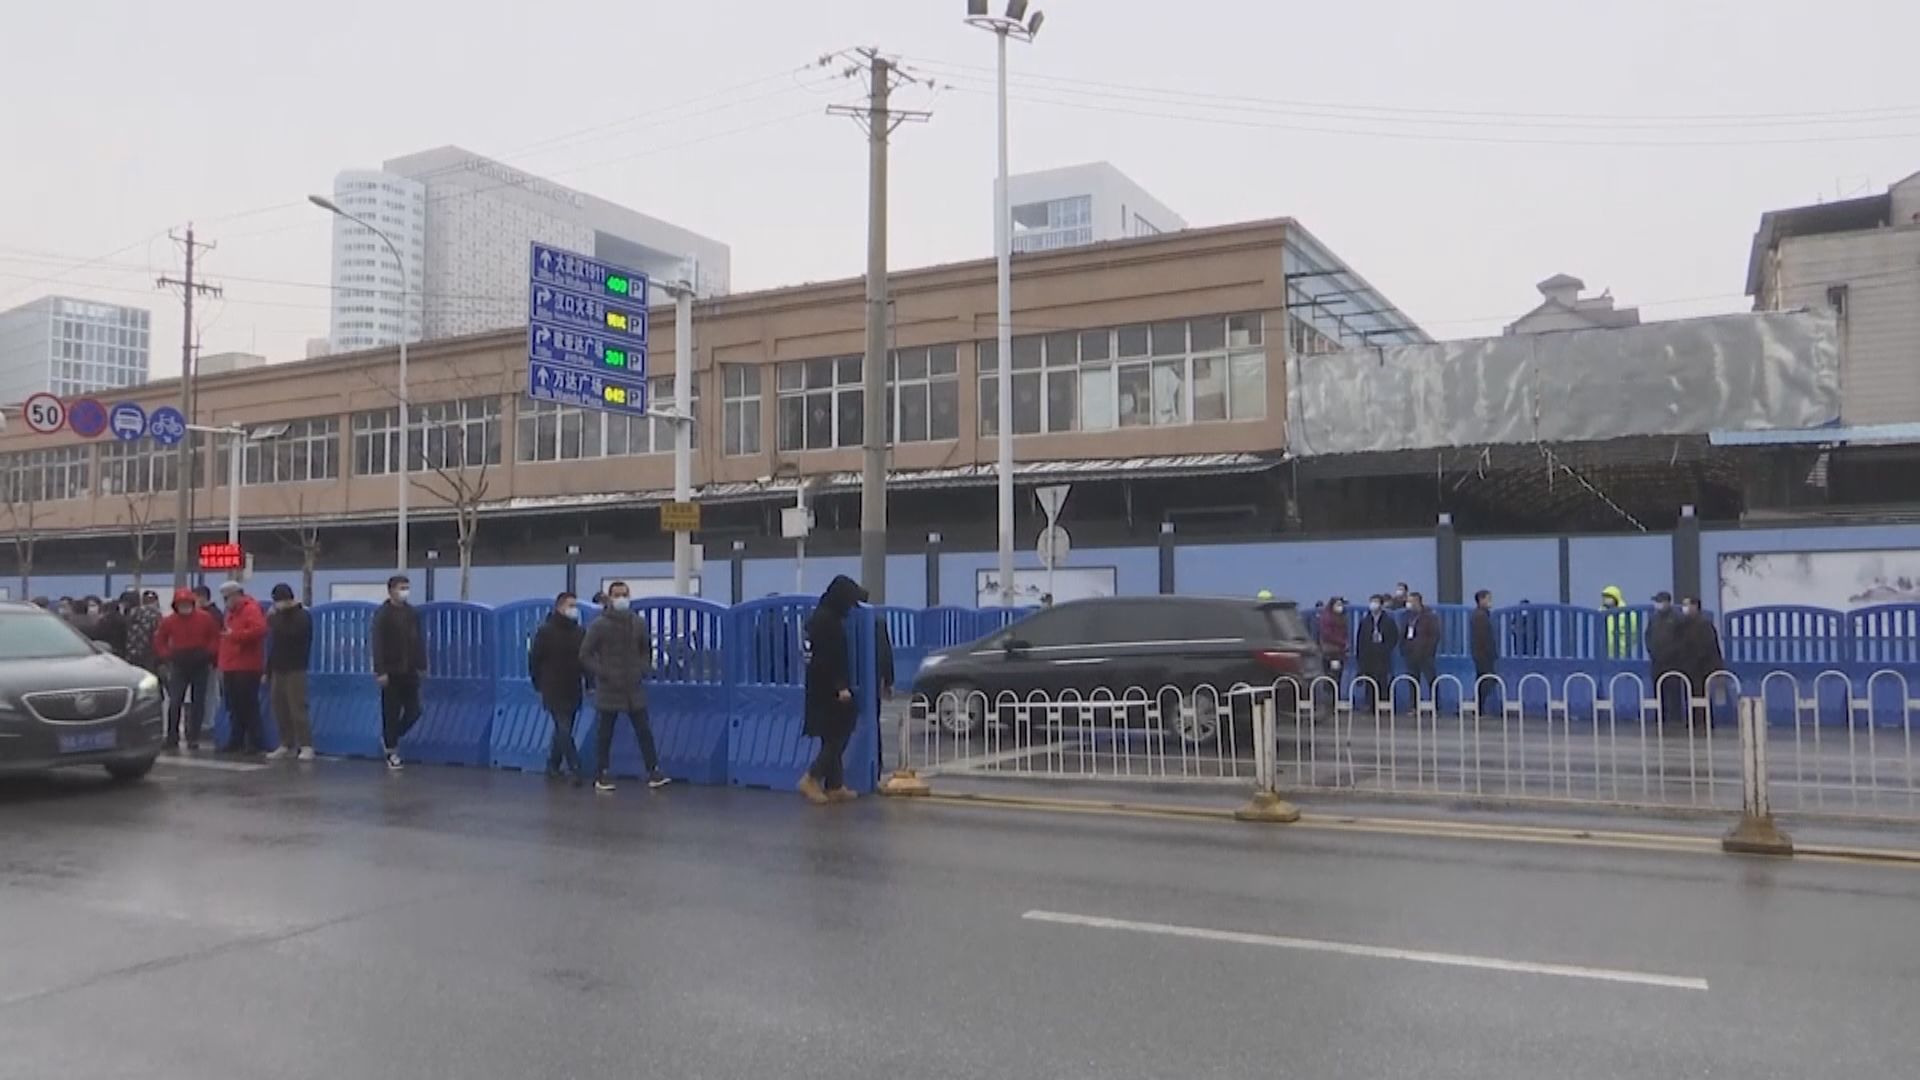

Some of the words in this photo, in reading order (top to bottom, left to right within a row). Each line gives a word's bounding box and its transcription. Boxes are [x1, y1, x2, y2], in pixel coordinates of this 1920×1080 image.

[631, 281, 640, 297] P
[630, 317, 640, 331] P
[630, 353, 639, 368] P
[553, 370, 602, 396] 万达广场
[629, 390, 639, 405] P
[32, 404, 58, 425] 50
